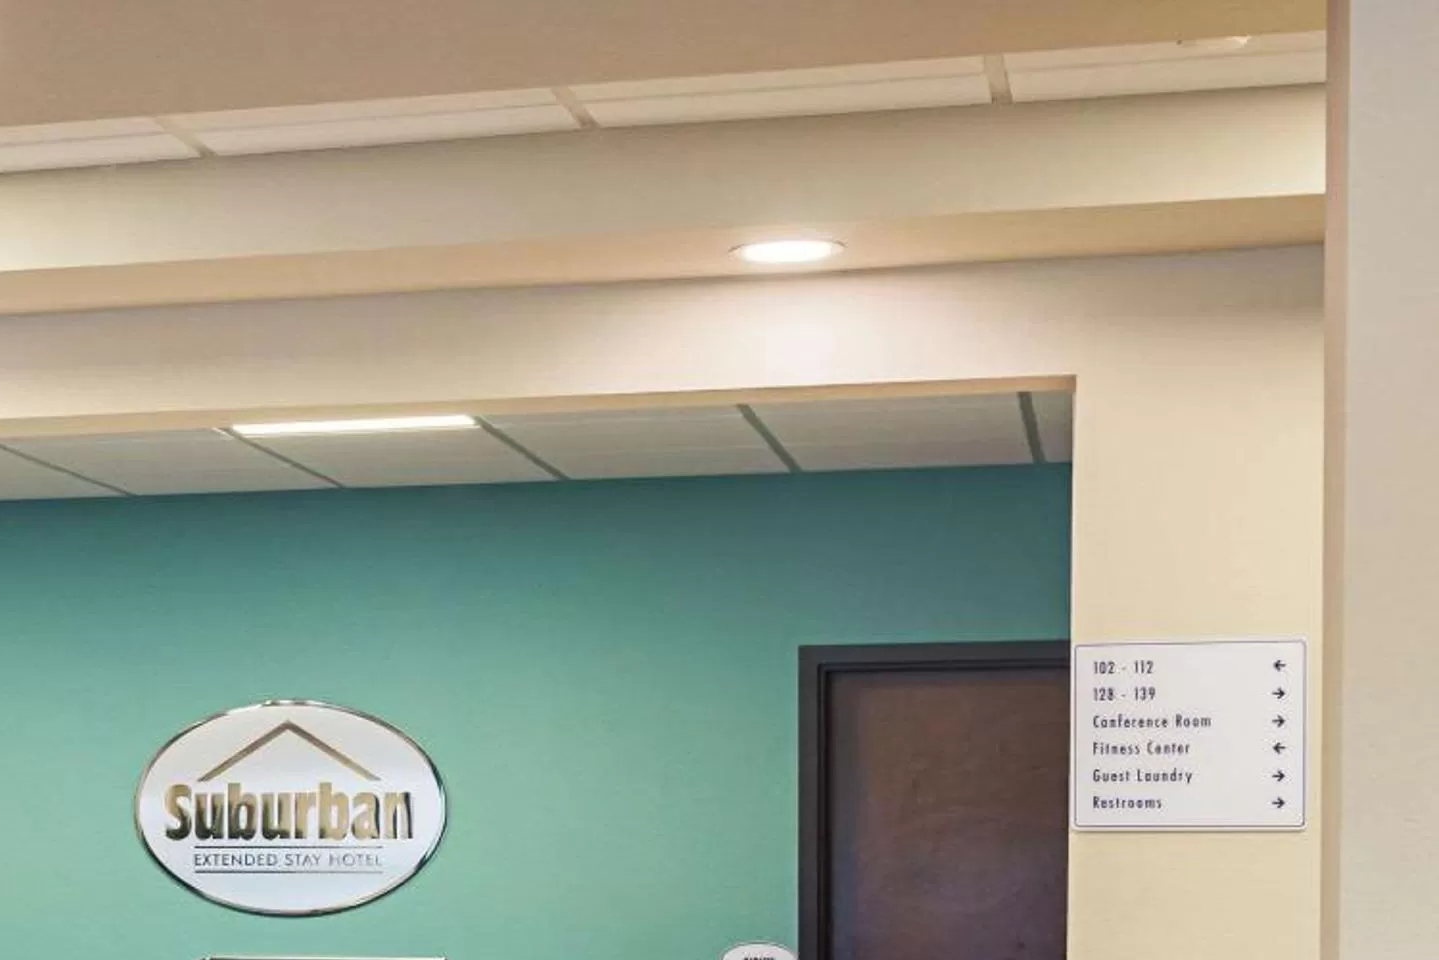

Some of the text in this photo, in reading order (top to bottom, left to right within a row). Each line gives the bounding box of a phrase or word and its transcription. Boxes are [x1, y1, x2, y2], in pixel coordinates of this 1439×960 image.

[1093, 661, 1115, 674] 102
[1134, 660, 1154, 673] 112
[1093, 687, 1114, 701] 128
[1134, 686, 1156, 700] 139
[1093, 714, 1212, 728] Conference Room
[1093, 742, 1190, 755] Fitness Center
[1093, 768, 1193, 784] Guest Laundry
[1093, 796, 1162, 809] Restrooms
[165, 782, 413, 841] Suburban
[194, 853, 382, 867] EXTENDED STAY HOTEL
